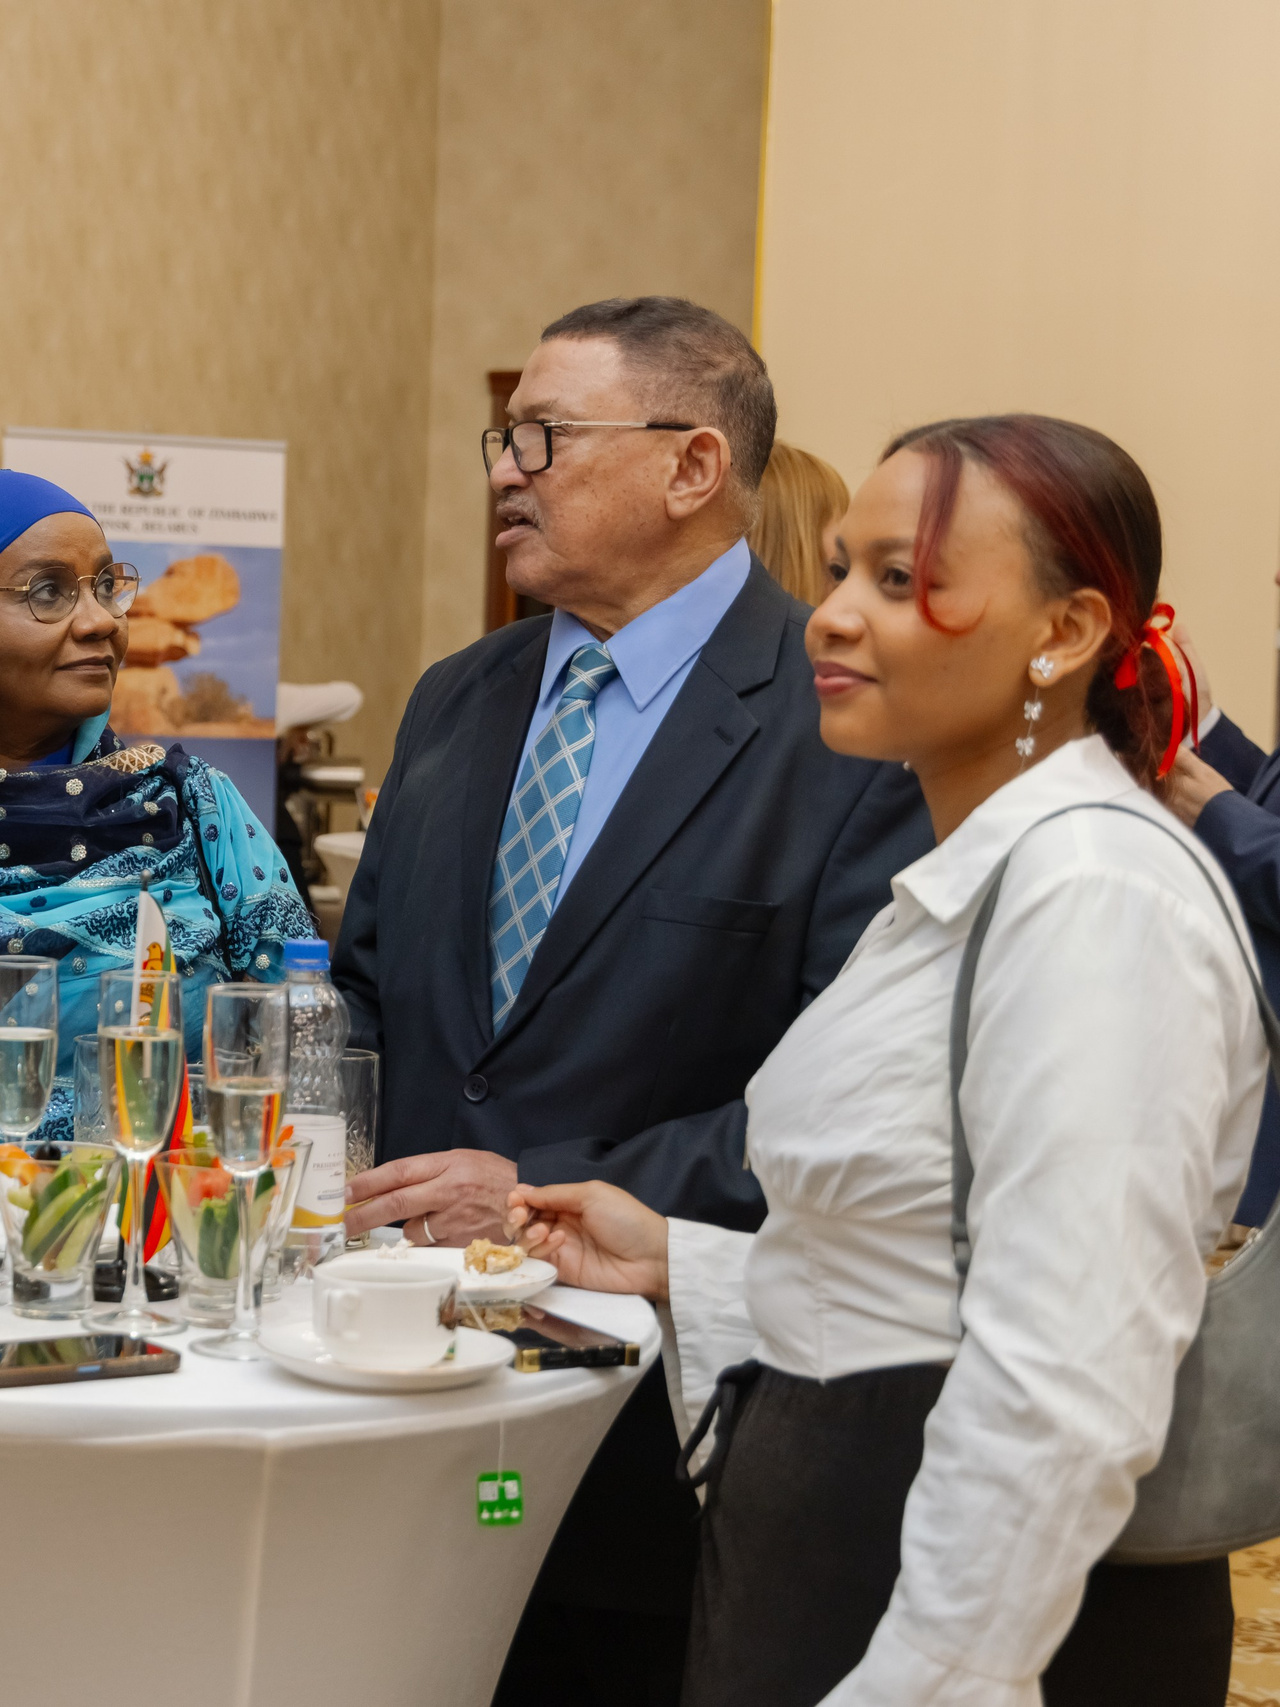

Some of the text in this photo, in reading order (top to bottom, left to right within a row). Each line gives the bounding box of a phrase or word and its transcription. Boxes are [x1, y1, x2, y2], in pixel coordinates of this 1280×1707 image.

[120, 505, 180, 518] REPUBLIC
[187, 506, 206, 519] OF
[208, 507, 279, 523] ZIMBABWE
